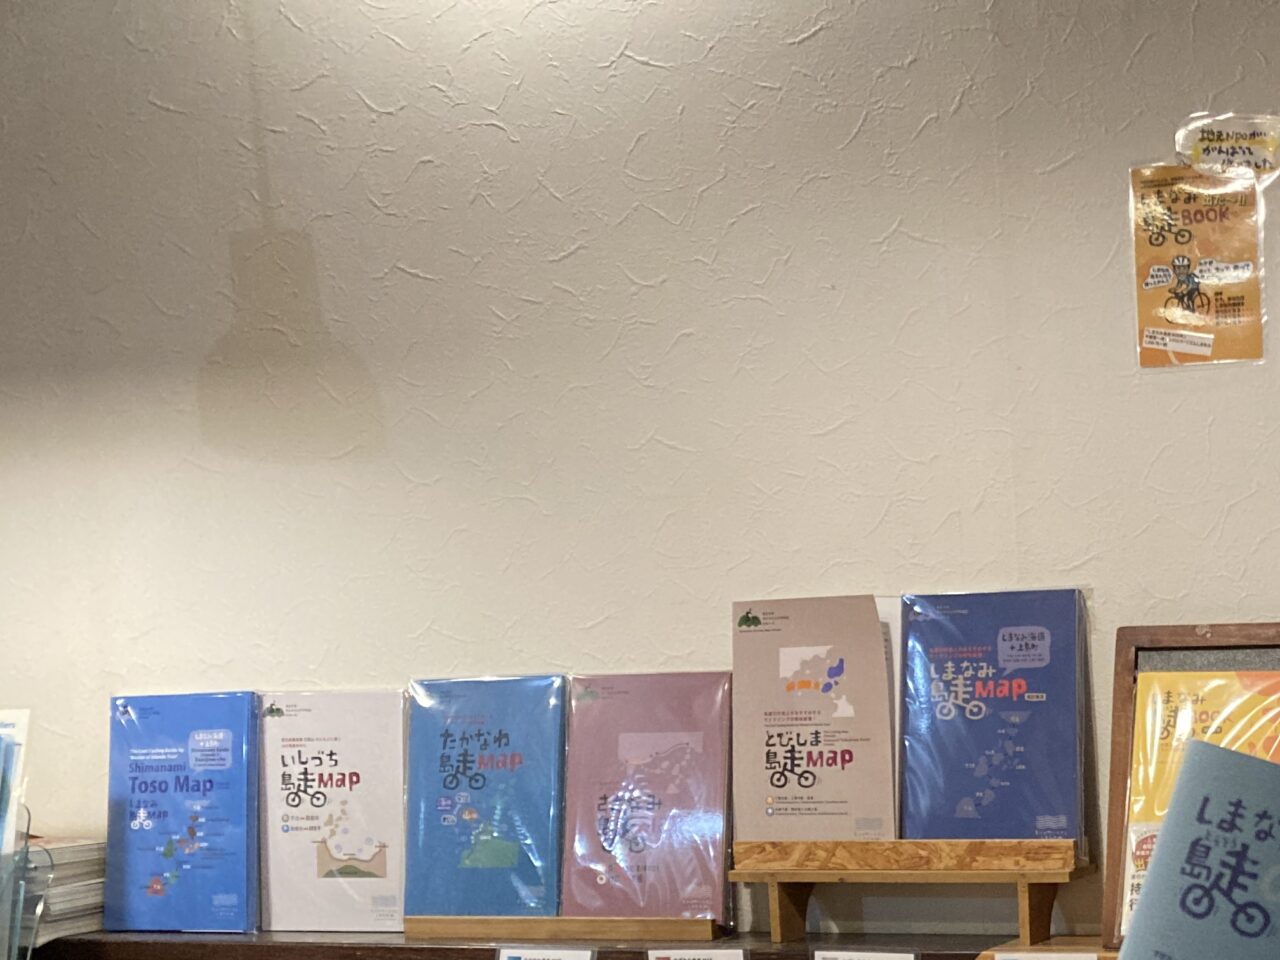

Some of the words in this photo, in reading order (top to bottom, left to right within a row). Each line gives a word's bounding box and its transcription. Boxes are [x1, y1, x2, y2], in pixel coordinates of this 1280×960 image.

[931, 661, 996, 680] しまなみ
[440, 729, 510, 751] たかなわ
[765, 730, 822, 747] とびしま
[281, 750, 338, 767] いしづち
[129, 763, 186, 774] Shimanami
[129, 777, 169, 794] Toso
[174, 775, 214, 797] Map
